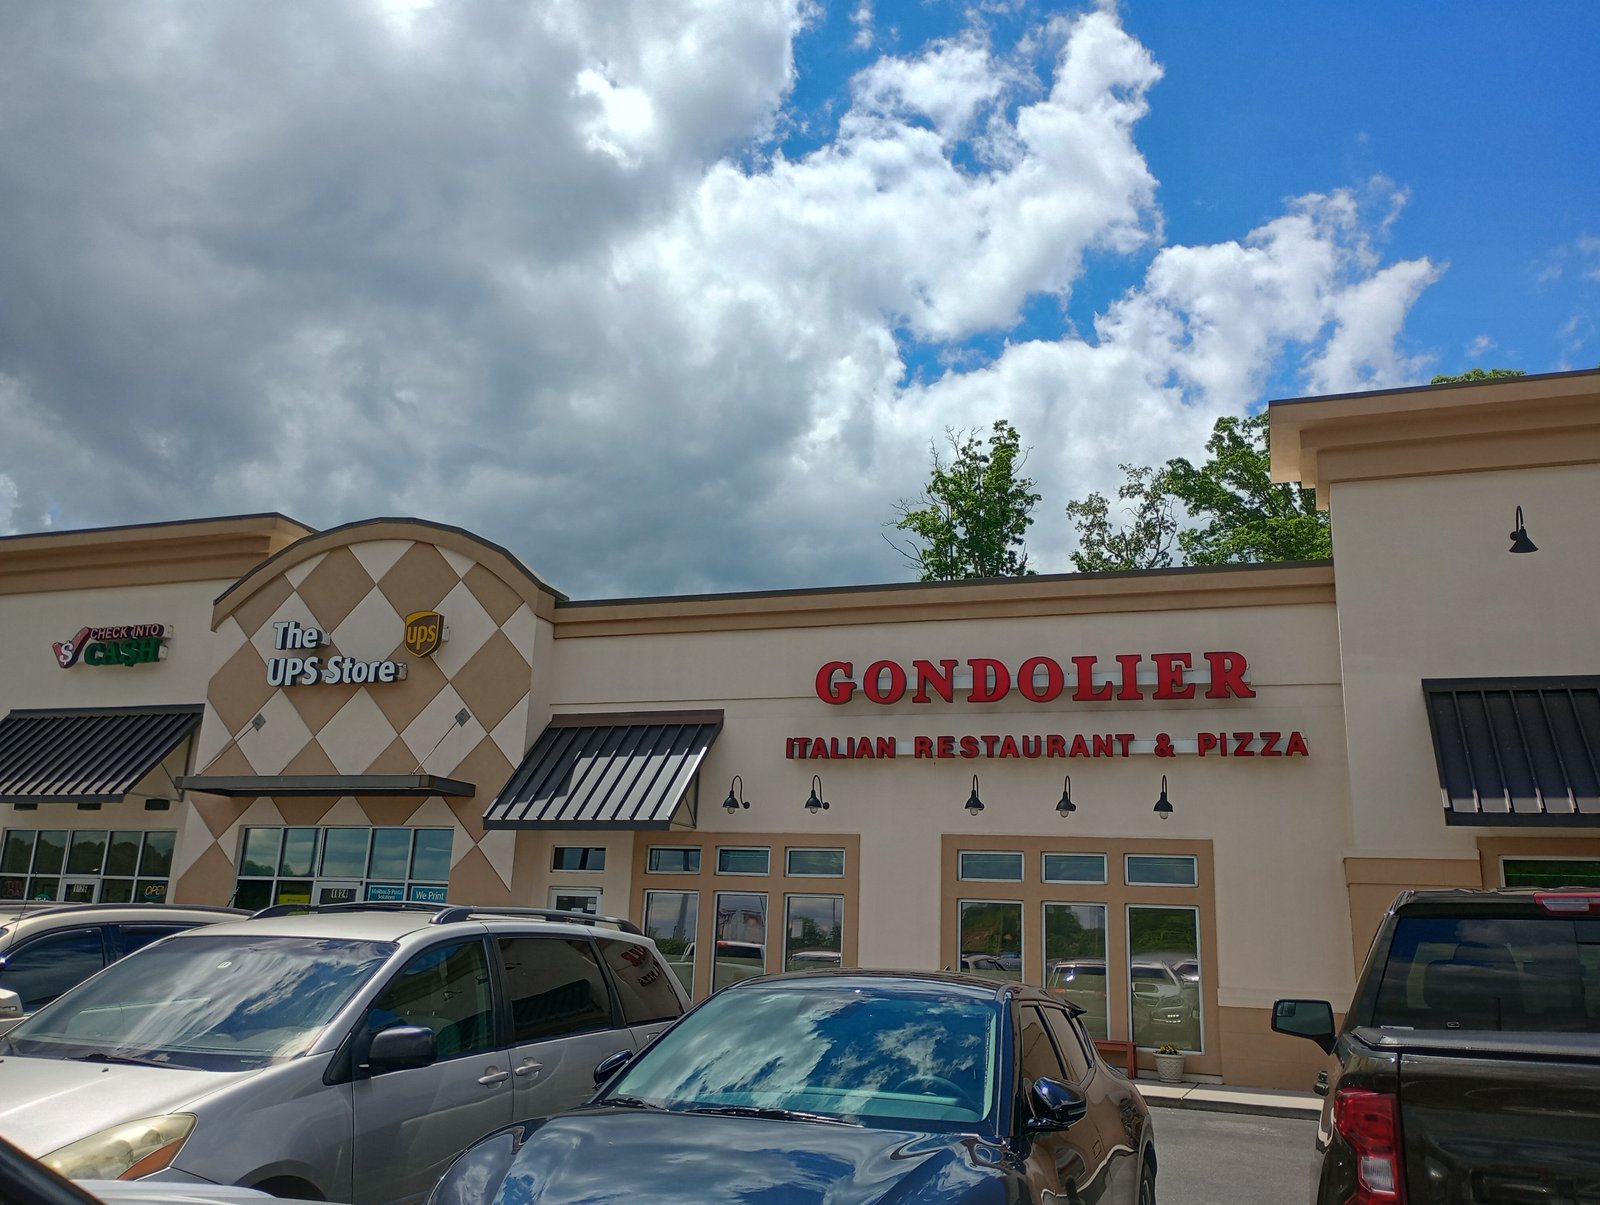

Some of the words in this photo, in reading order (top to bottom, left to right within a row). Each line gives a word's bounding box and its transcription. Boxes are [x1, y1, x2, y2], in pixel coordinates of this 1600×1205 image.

[90, 626, 129, 640] CHECK
[131, 623, 162, 637] INTO
[273, 621, 321, 650] The
[407, 625, 437, 650] ups
[266, 656, 321, 687] UPS
[325, 656, 397, 685] Store
[815, 651, 1257, 705] GONDOLIER
[786, 736, 897, 759] ITALIAN
[914, 733, 1135, 759] RESTAURANT
[1154, 732, 1177, 758] &
[1197, 731, 1309, 757] PIZZA
[416, 890, 427, 900] We
[428, 891, 444, 900] Print
